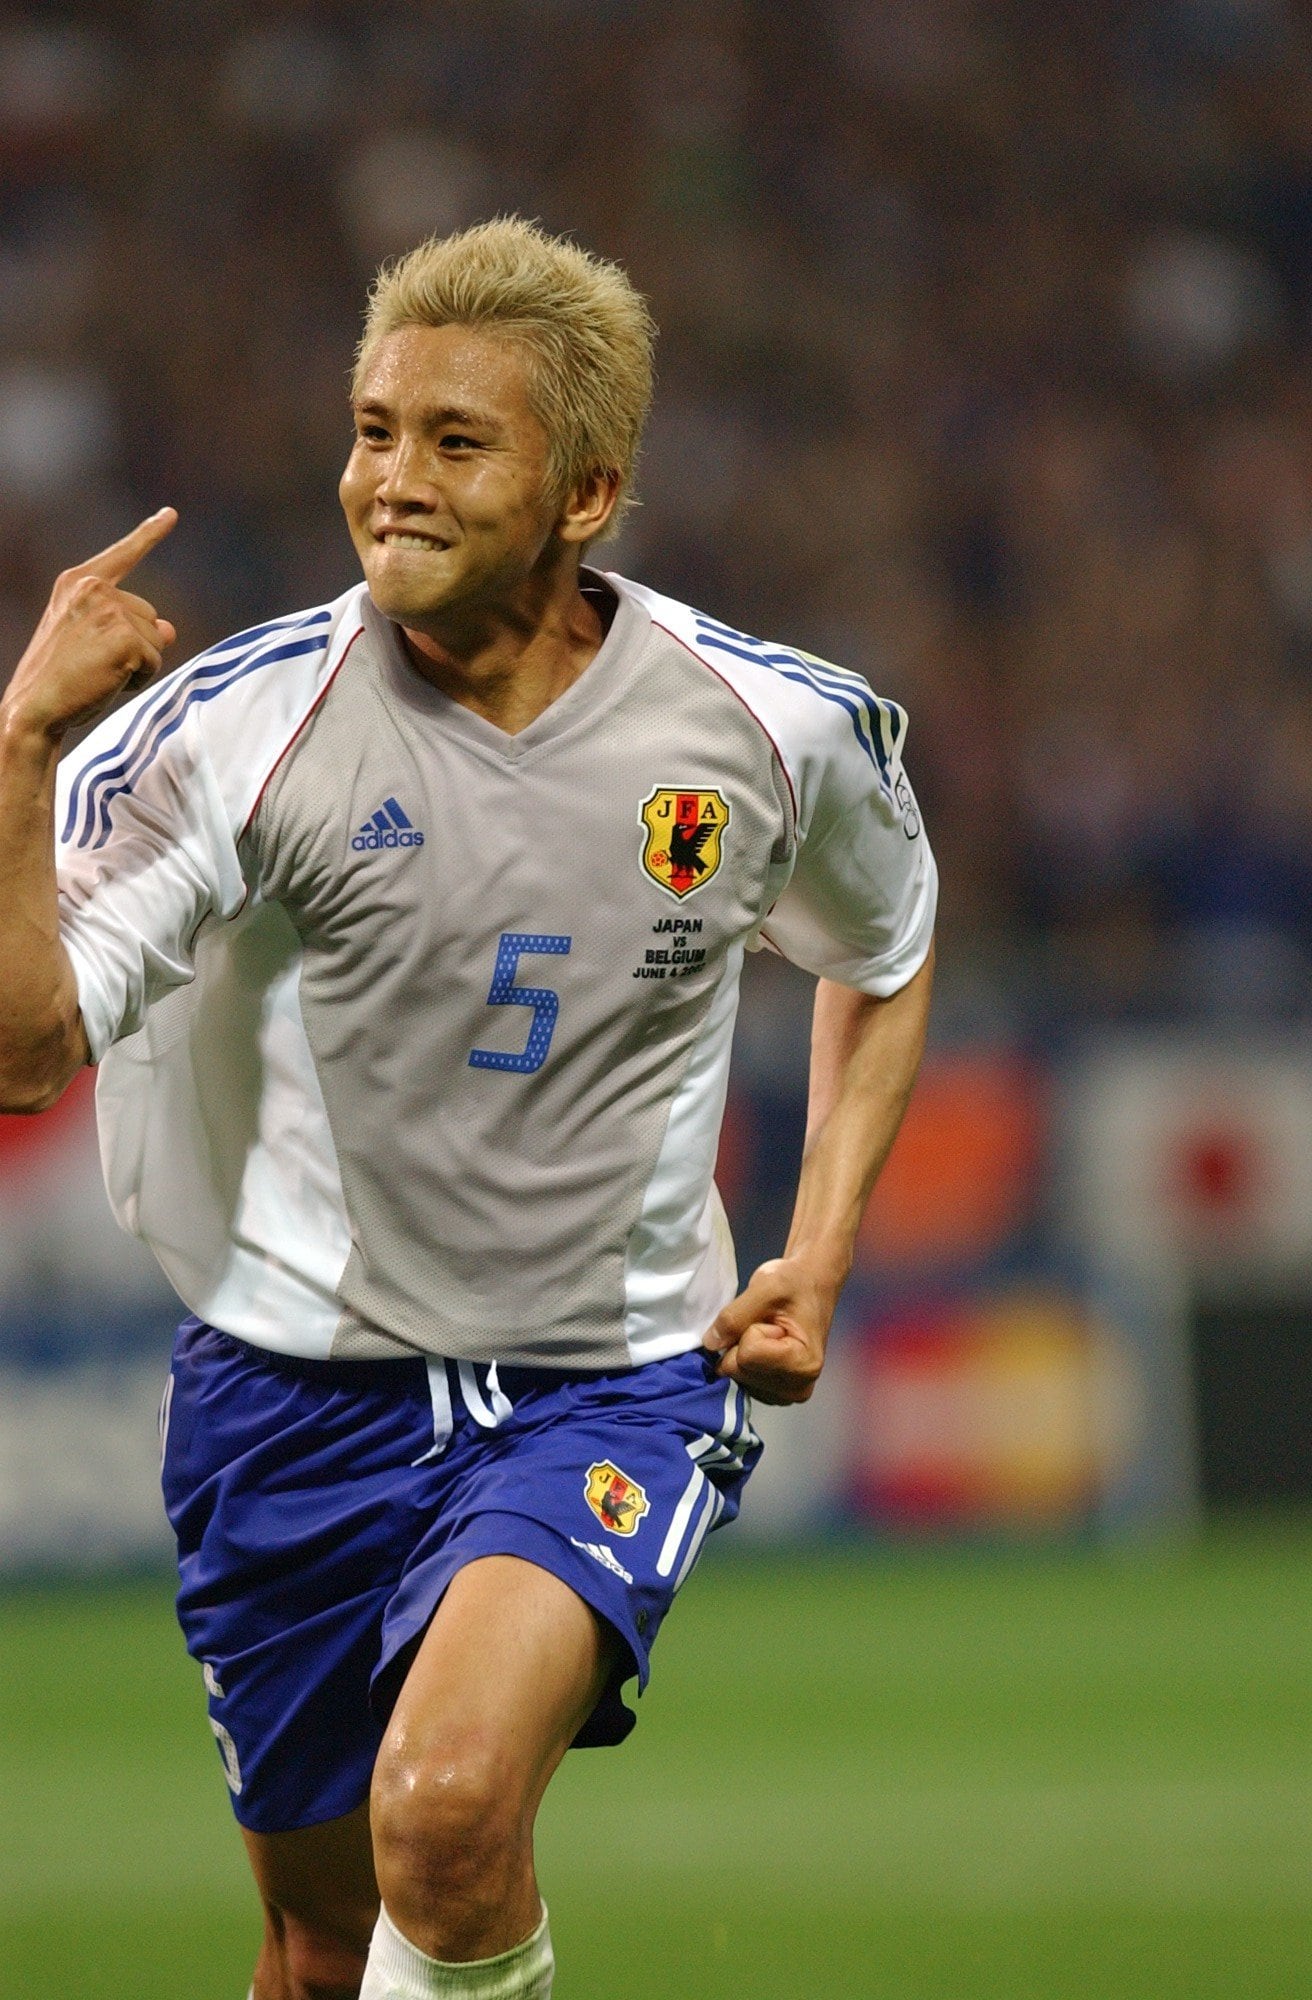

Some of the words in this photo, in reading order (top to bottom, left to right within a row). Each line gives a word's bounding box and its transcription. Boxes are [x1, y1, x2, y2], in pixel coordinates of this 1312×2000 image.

[657, 800, 718, 820] JFA
[351, 829, 425, 851] adidas
[653, 919, 703, 934] JAPAN
[673, 936, 687, 948] VS
[645, 949, 706, 965] BELGIUM
[632, 967, 667, 979] JUNE
[669, 967, 678, 978] 4
[468, 933, 572, 1074] 5
